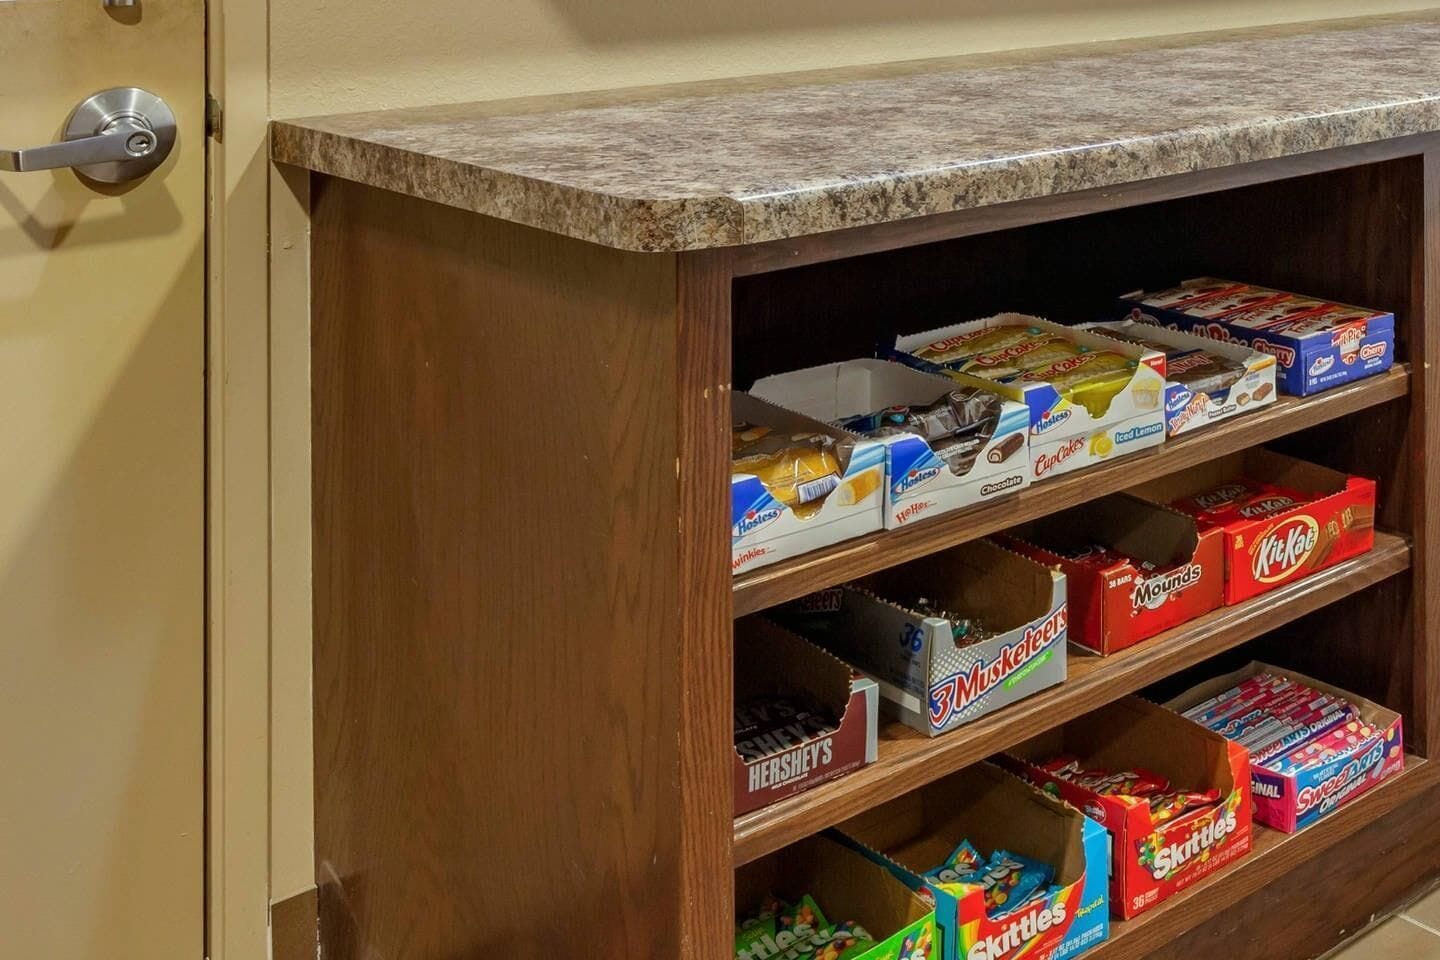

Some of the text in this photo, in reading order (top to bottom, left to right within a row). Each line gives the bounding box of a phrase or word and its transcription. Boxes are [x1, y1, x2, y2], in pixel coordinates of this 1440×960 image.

[1362, 343, 1386, 358] Cherry
[1036, 412, 1069, 433] Hostess
[1116, 423, 1163, 443] Iced Lemon
[1035, 436, 1085, 476] CupCakes
[901, 468, 937, 492] Hostess
[981, 476, 1022, 495] Chocolate
[738, 509, 778, 536] Hostess
[732, 546, 766, 569] winkies
[1133, 565, 1201, 608] Mounds
[930, 608, 1067, 725] 3 Musketeers
[1310, 710, 1346, 731] ORIGINAL
[749, 737, 833, 793] HERSHEY'S
[1320, 773, 1367, 814] ORIGINAL
[1153, 811, 1237, 880] Skittles
[1132, 894, 1146, 910] 36
[967, 902, 1067, 960] Skittles
